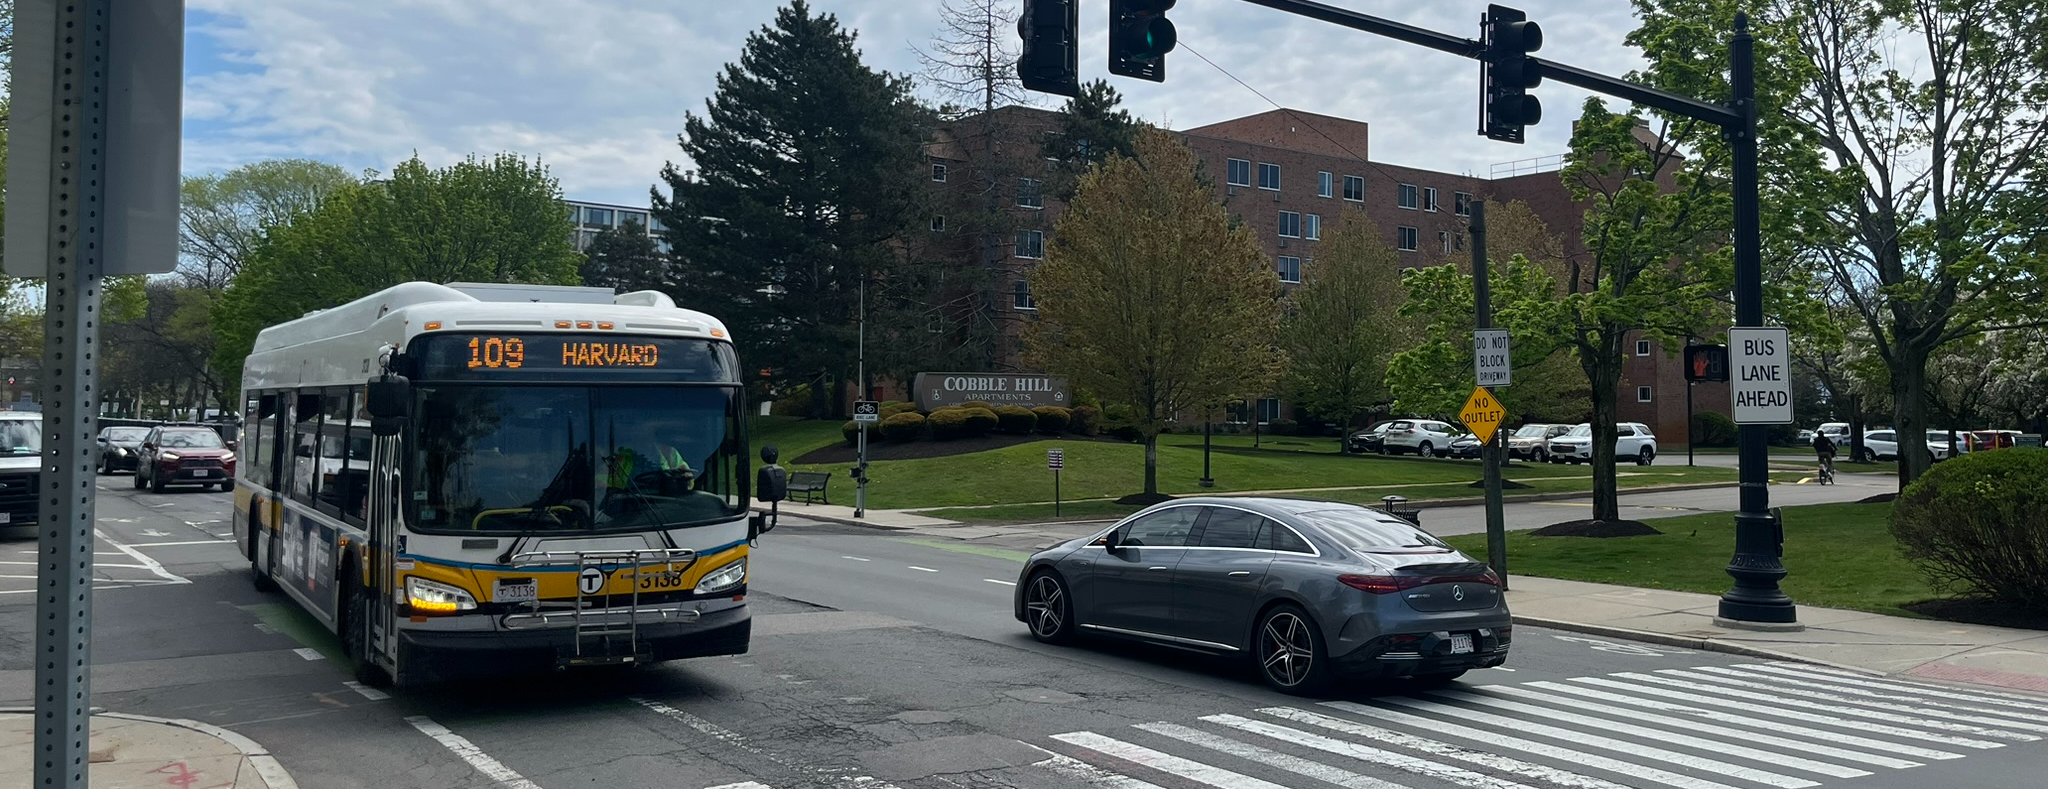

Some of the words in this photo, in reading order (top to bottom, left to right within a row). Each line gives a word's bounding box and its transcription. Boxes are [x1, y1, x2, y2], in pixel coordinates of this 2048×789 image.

[1476, 337, 1486, 349] DO
[1492, 337, 1507, 349] NOT
[1744, 340, 1774, 356] BUS
[467, 337, 524, 368] 109
[562, 342, 658, 366] HARVARD
[1480, 355, 1505, 368] BLOCK
[1480, 372, 1507, 381] DRIVEWAY
[1741, 365, 1781, 381] LANE
[943, 376, 1007, 391] COBBLE
[1014, 378, 1053, 392] HILL
[1474, 398, 1488, 408] NO
[1736, 391, 1787, 406] AHEAD
[1464, 411, 1500, 423] OUTLET
[640, 570, 682, 589] 3138
[510, 585, 535, 598] 3138
